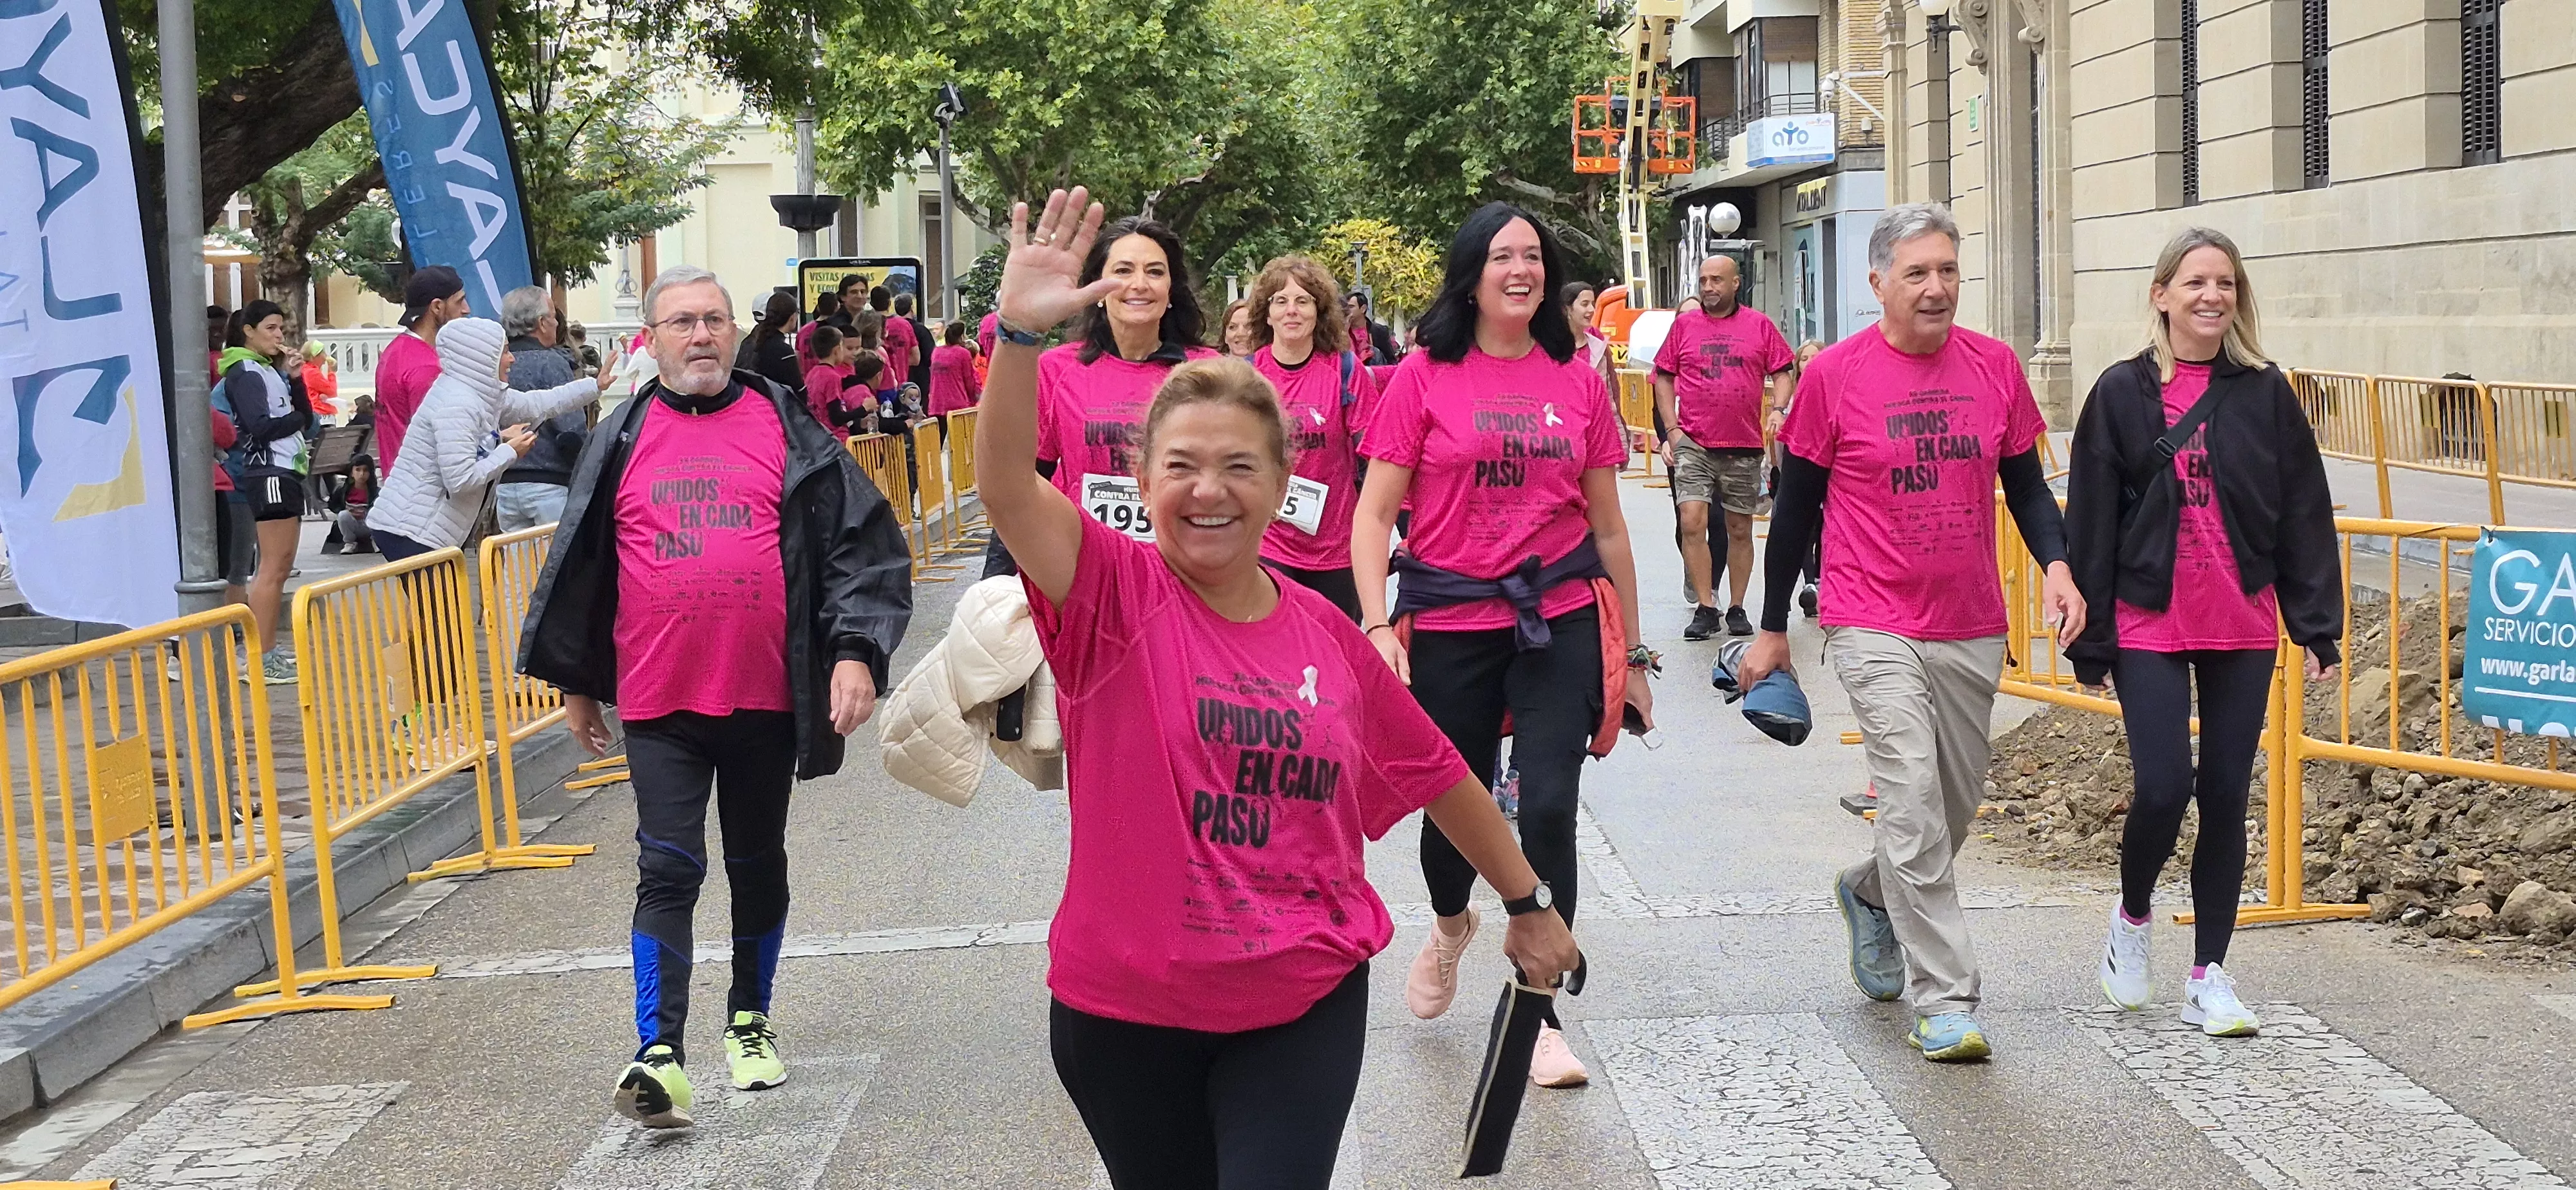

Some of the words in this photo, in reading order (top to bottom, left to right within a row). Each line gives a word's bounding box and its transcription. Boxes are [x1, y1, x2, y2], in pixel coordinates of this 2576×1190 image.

[810, 272, 839, 282] VISITAS
[1473, 411, 1539, 434] UNIDOS
[1886, 410, 1949, 440] UNIDOS
[1502, 435, 1526, 458] EN
[1528, 435, 1573, 461] CADA
[1915, 437, 1935, 462] EN
[1938, 435, 1982, 460] CADA
[650, 477, 719, 505] UNIDOS
[1094, 489, 1130, 500] CONTRA
[680, 505, 704, 529] EN
[705, 504, 753, 529] CADA
[2483, 616, 2576, 648] SERVICIO
[1197, 697, 1303, 751] UNIDOS
[1235, 750, 1274, 796] EN
